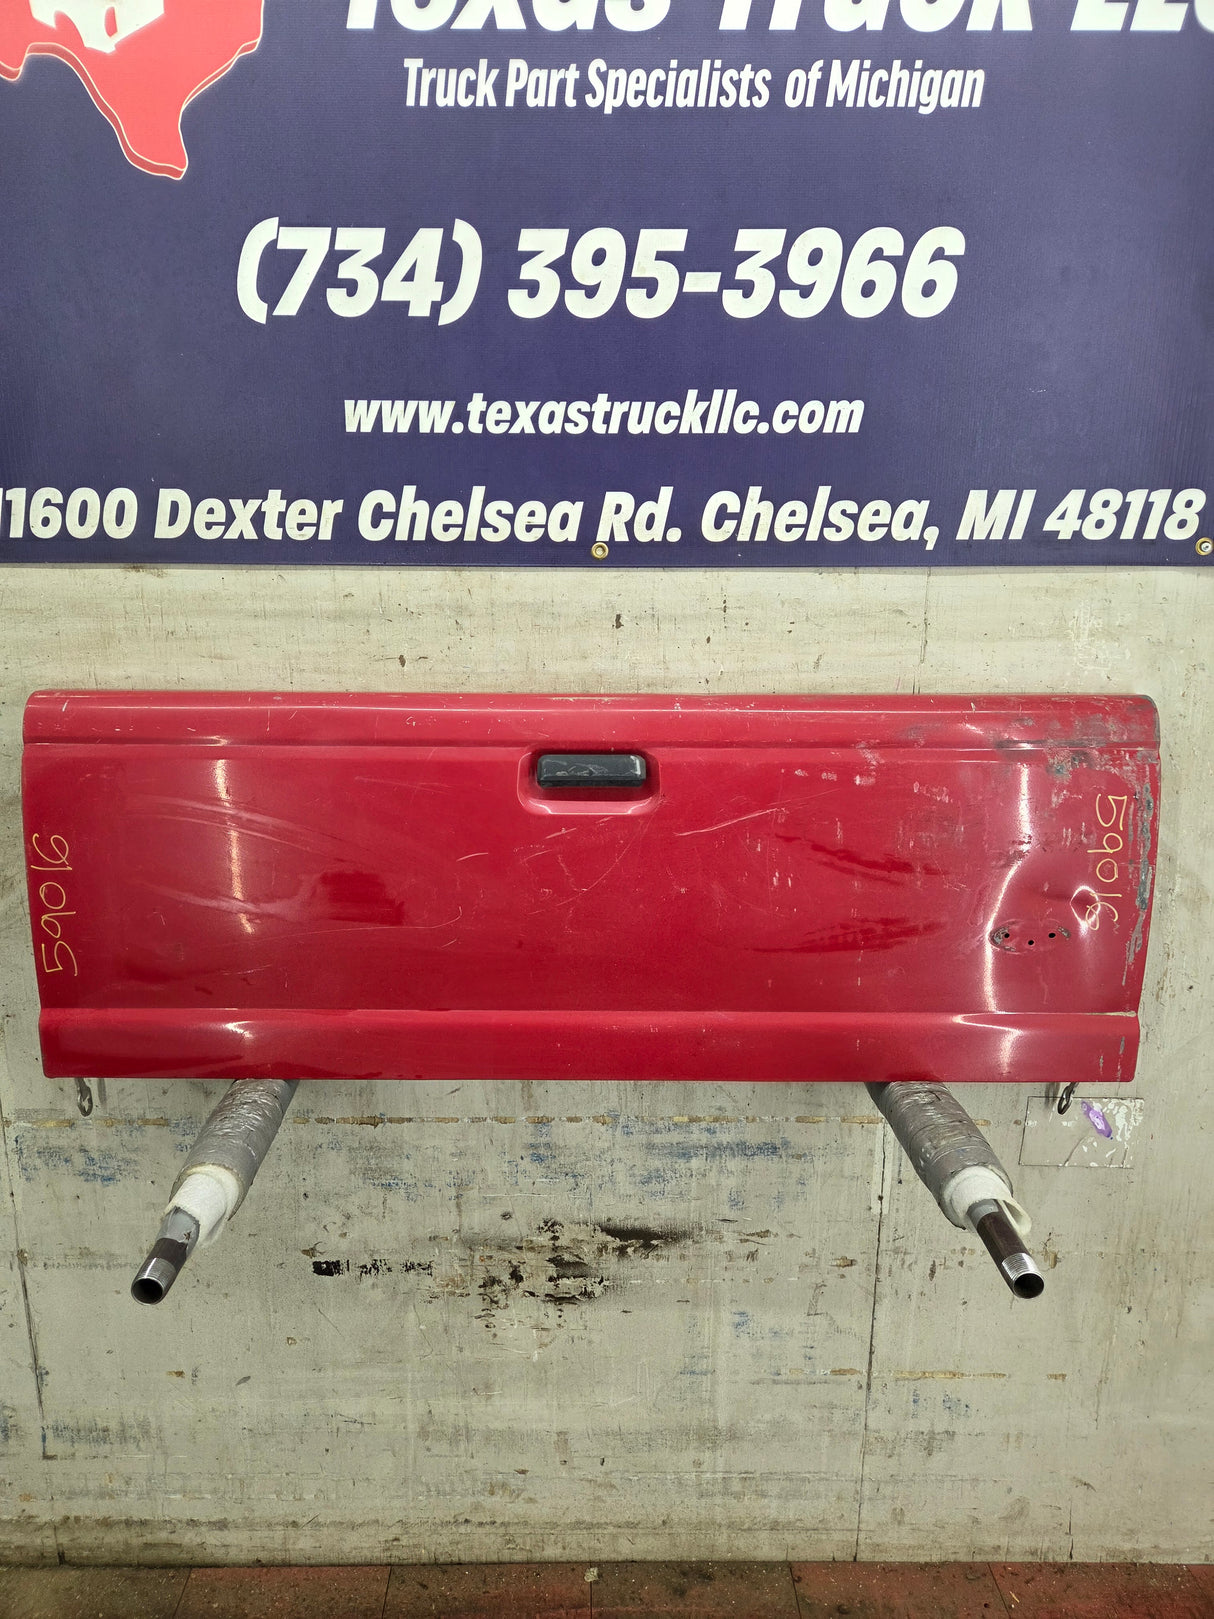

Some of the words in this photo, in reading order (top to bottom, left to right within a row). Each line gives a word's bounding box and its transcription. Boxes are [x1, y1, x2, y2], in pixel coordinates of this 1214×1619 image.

[403, 57, 500, 108] Truck
[504, 58, 581, 108] Part
[584, 58, 772, 115] Specialists
[784, 59, 825, 108] of
[825, 59, 986, 115] Michigan
[236, 216, 483, 326] (734)
[507, 226, 966, 319] 395-3966
[344, 388, 865, 435] www.texastruckllc.com
[0, 486, 138, 539] 1600
[153, 488, 344, 541] Dexter
[357, 485, 585, 543] Chelsea
[595, 486, 682, 543] Rd.
[701, 485, 940, 551] Chelsea,
[955, 489, 1037, 541] MI
[1042, 488, 1207, 541] 48118
[30, 833, 78, 977] 59016
[1087, 793, 1128, 931] 59016
